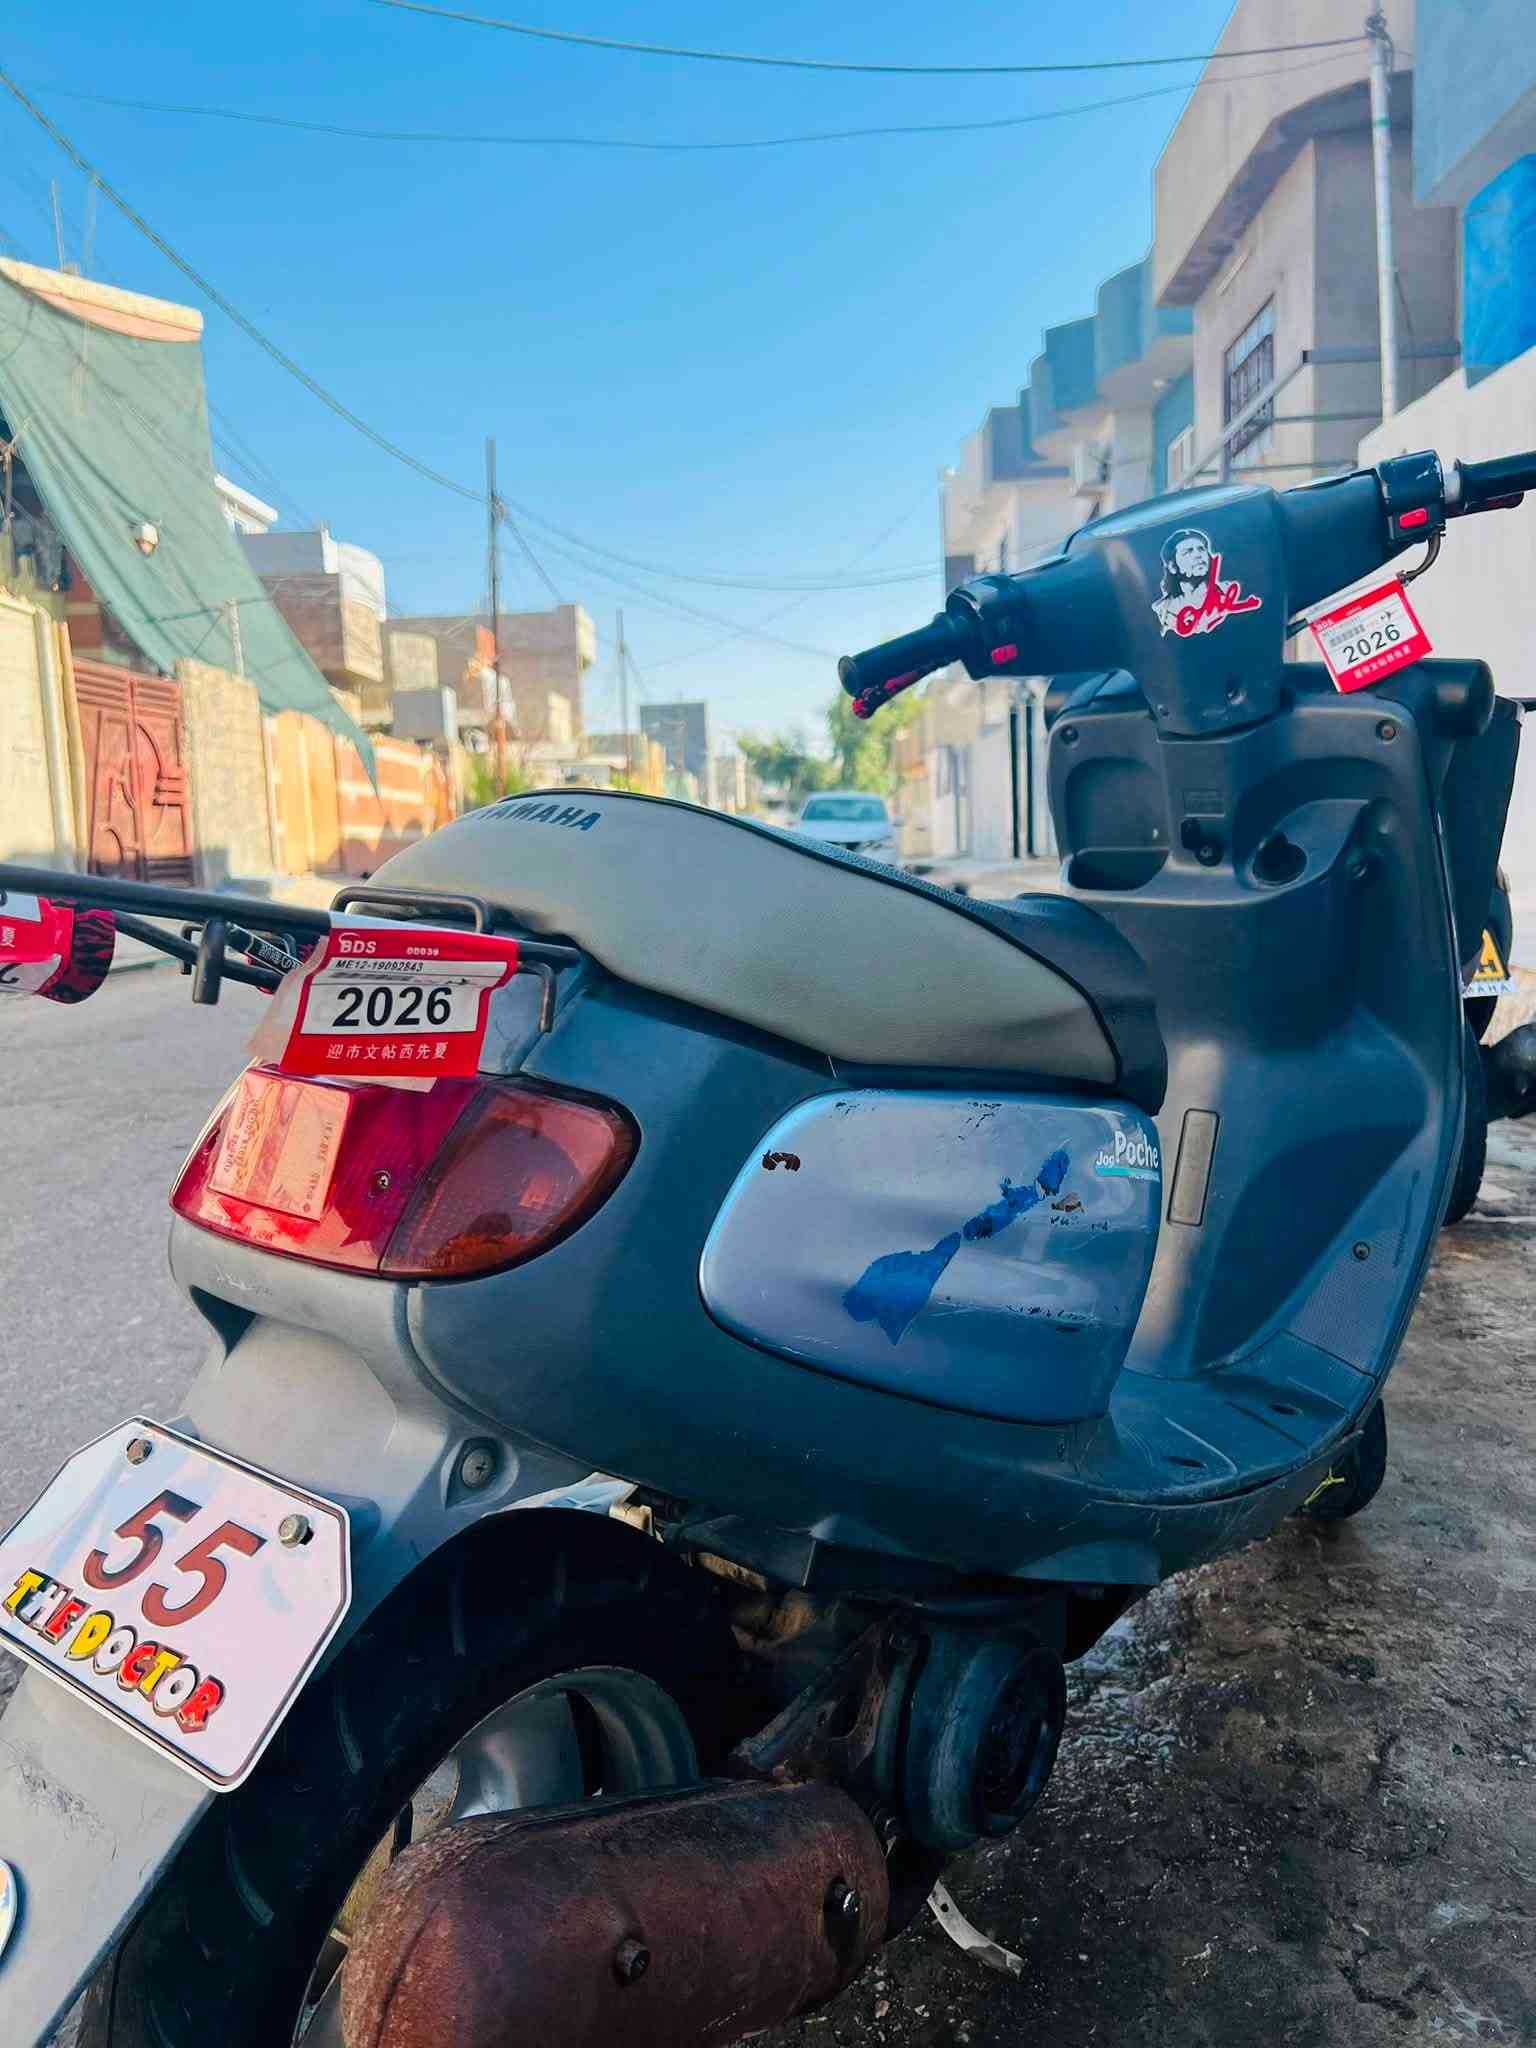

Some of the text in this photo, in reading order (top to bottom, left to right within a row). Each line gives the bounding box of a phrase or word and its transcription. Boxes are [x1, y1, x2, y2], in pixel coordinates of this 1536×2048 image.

[1342, 624, 1401, 664] 2026
[339, 938, 377, 954] BDS
[332, 986, 452, 1027] 2026
[1096, 1130, 1159, 1168] Jog Poche
[82, 1489, 267, 1629] 55
[3, 1568, 226, 1734] THE DOCTOR
